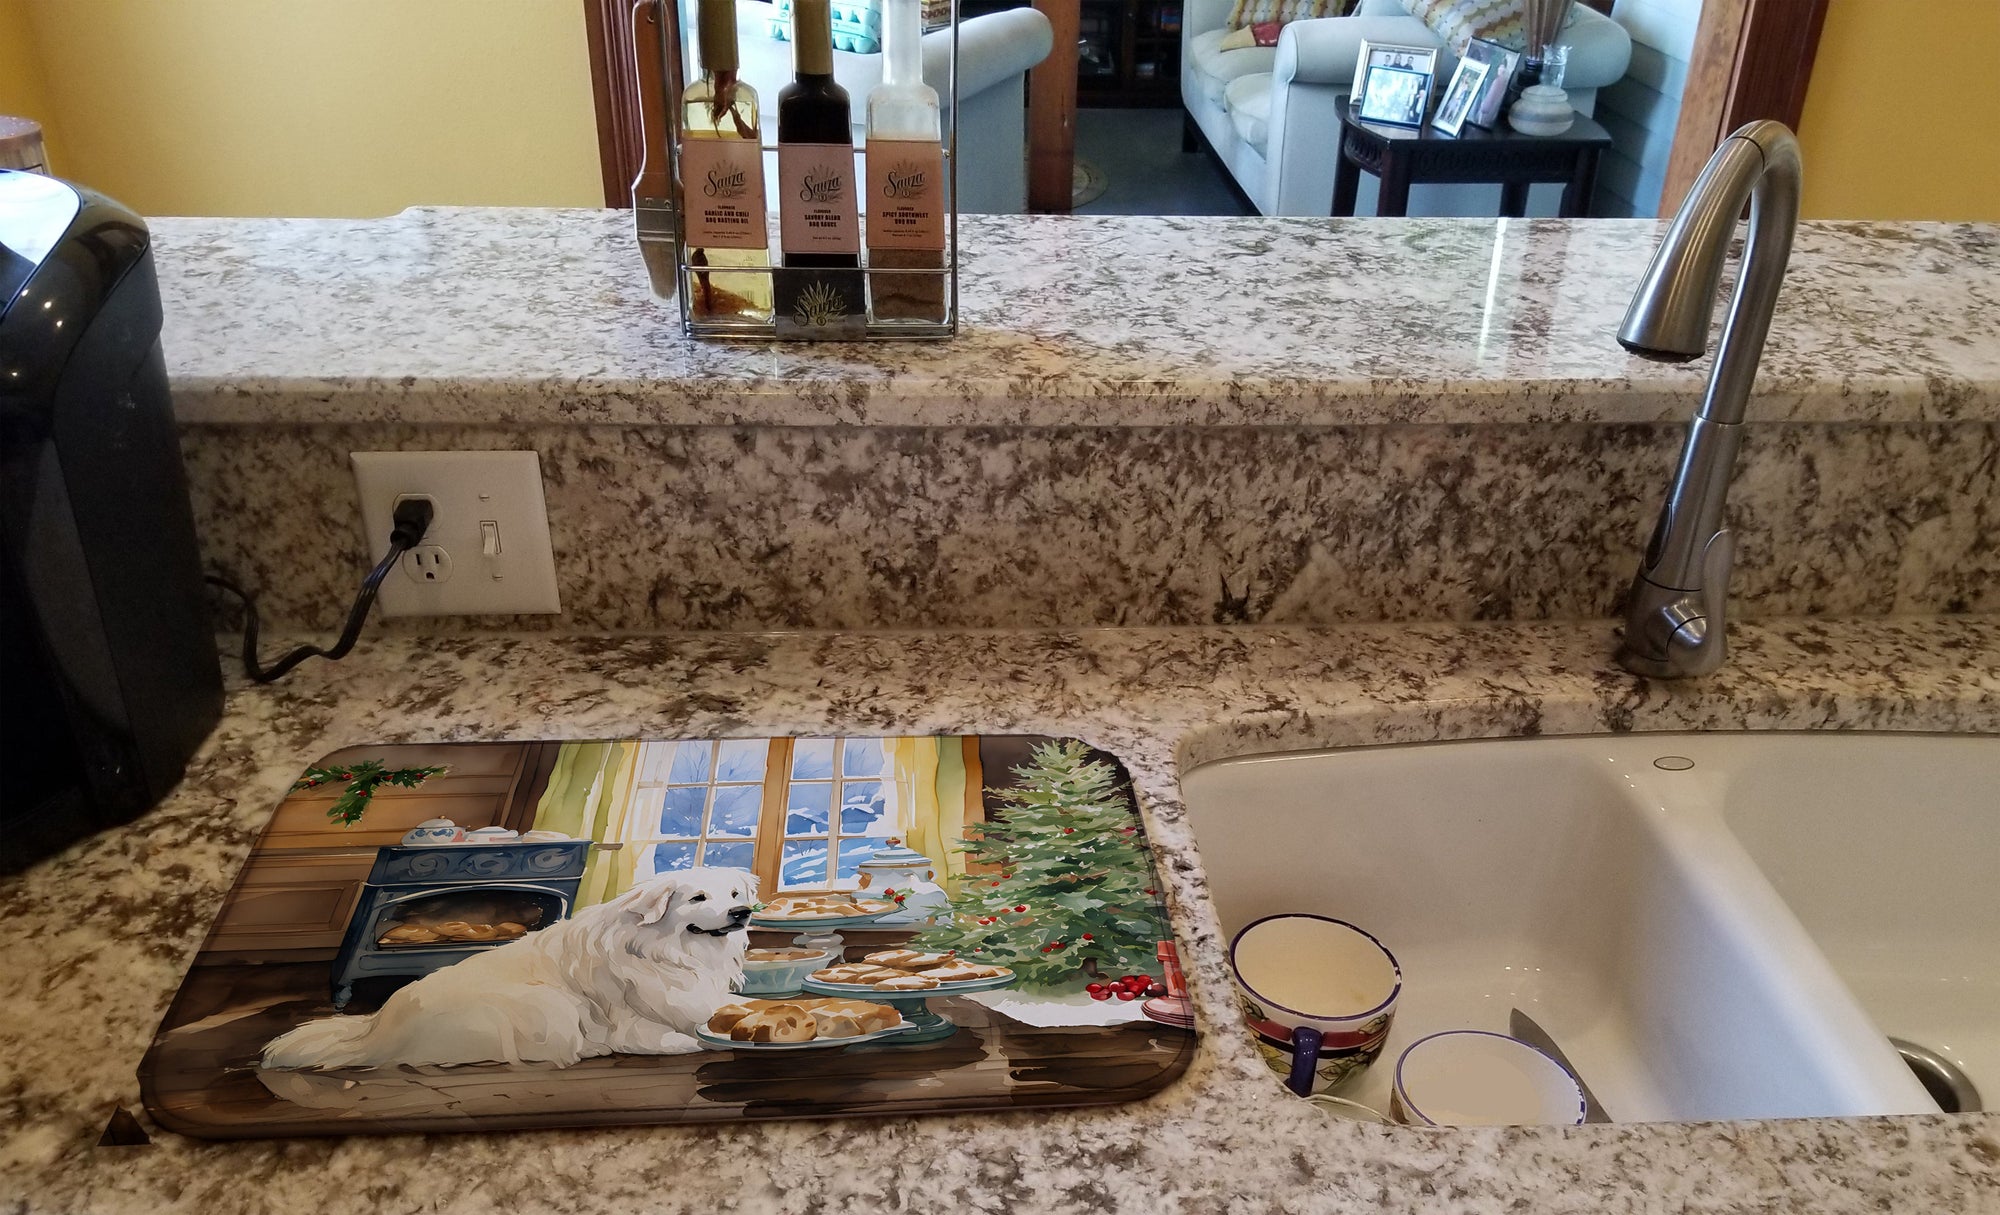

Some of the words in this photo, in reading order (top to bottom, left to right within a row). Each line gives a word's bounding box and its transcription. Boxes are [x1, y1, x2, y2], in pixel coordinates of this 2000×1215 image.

[703, 170, 745, 197] Sauza
[800, 175, 842, 202] Sauza
[883, 171, 925, 198] Sauza
